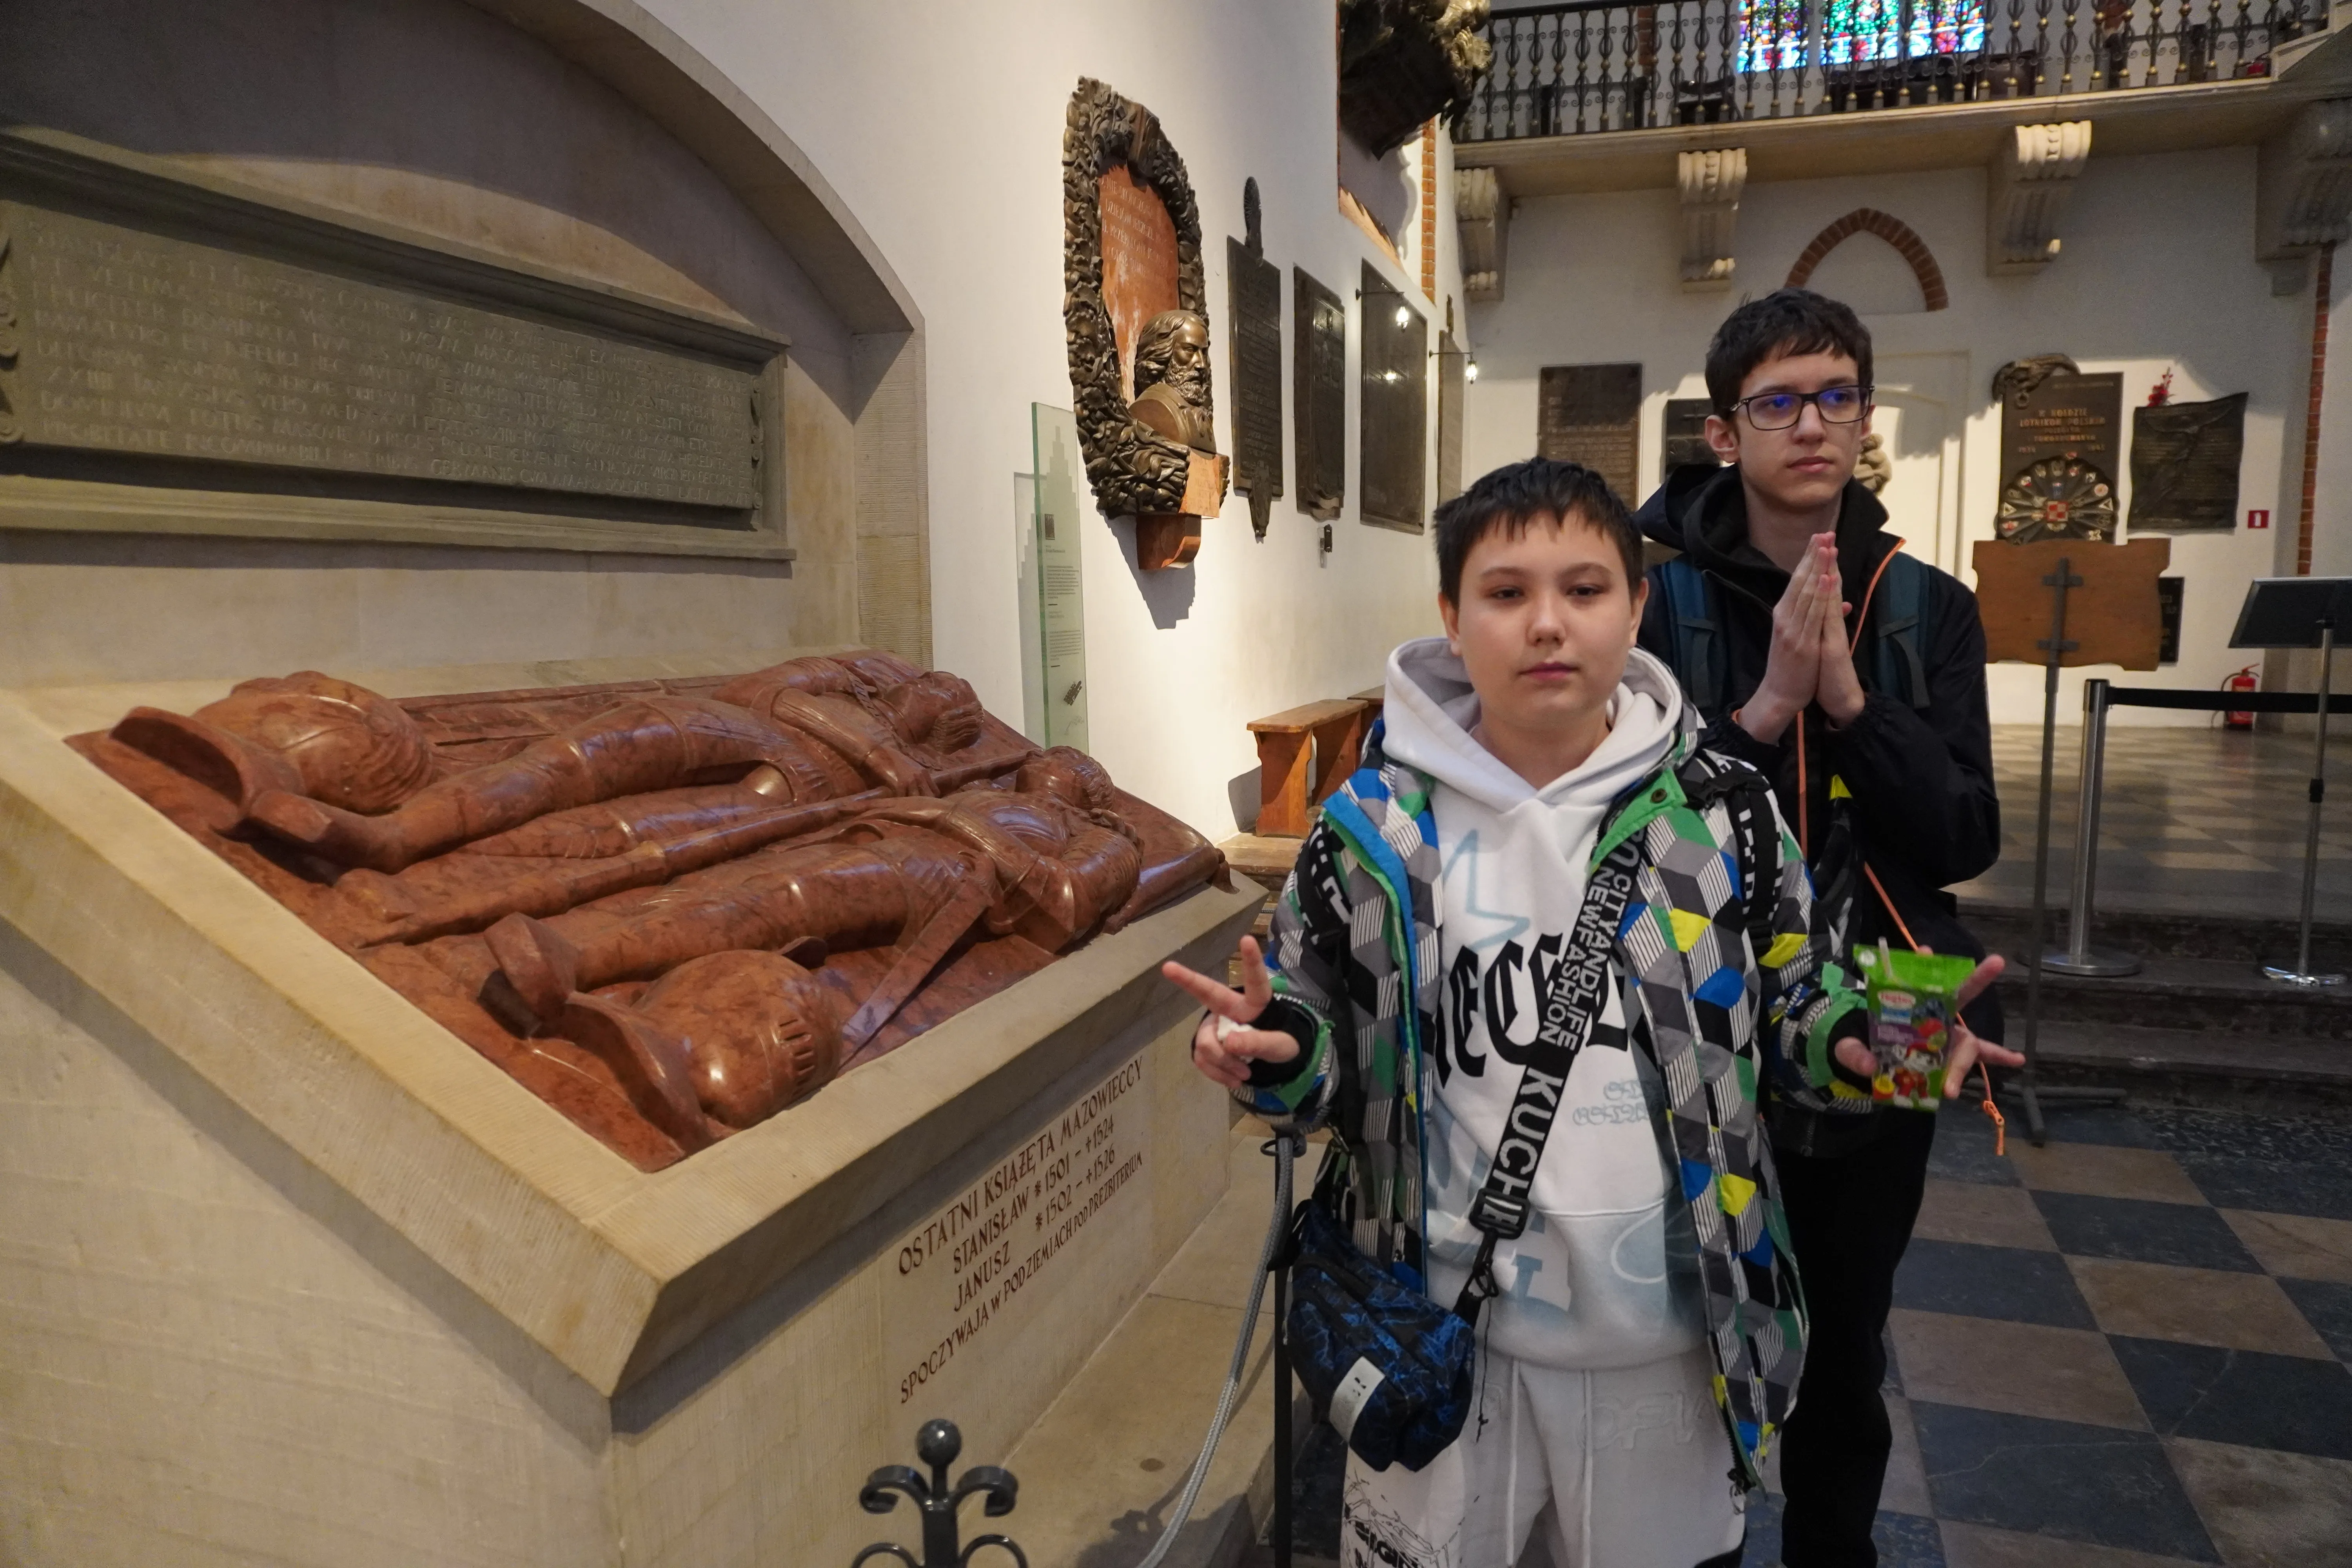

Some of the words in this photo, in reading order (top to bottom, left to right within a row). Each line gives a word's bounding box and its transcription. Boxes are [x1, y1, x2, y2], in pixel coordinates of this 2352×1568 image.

[899, 1189, 978, 1274] OSTATNI
[1060, 1056, 1142, 1145] MAZOWIECCY
[954, 1186, 1029, 1274] STANISŁAW
[901, 1301, 989, 1403] SPOCZYWAJĄ
[991, 1290, 1000, 1313] W
[1004, 1218, 1072, 1303] PODZIEMIACH
[1074, 1206, 1088, 1232] POD
[1089, 1151, 1142, 1216] PREZBITERIUM
[954, 1240, 1011, 1312] JANUSZ
